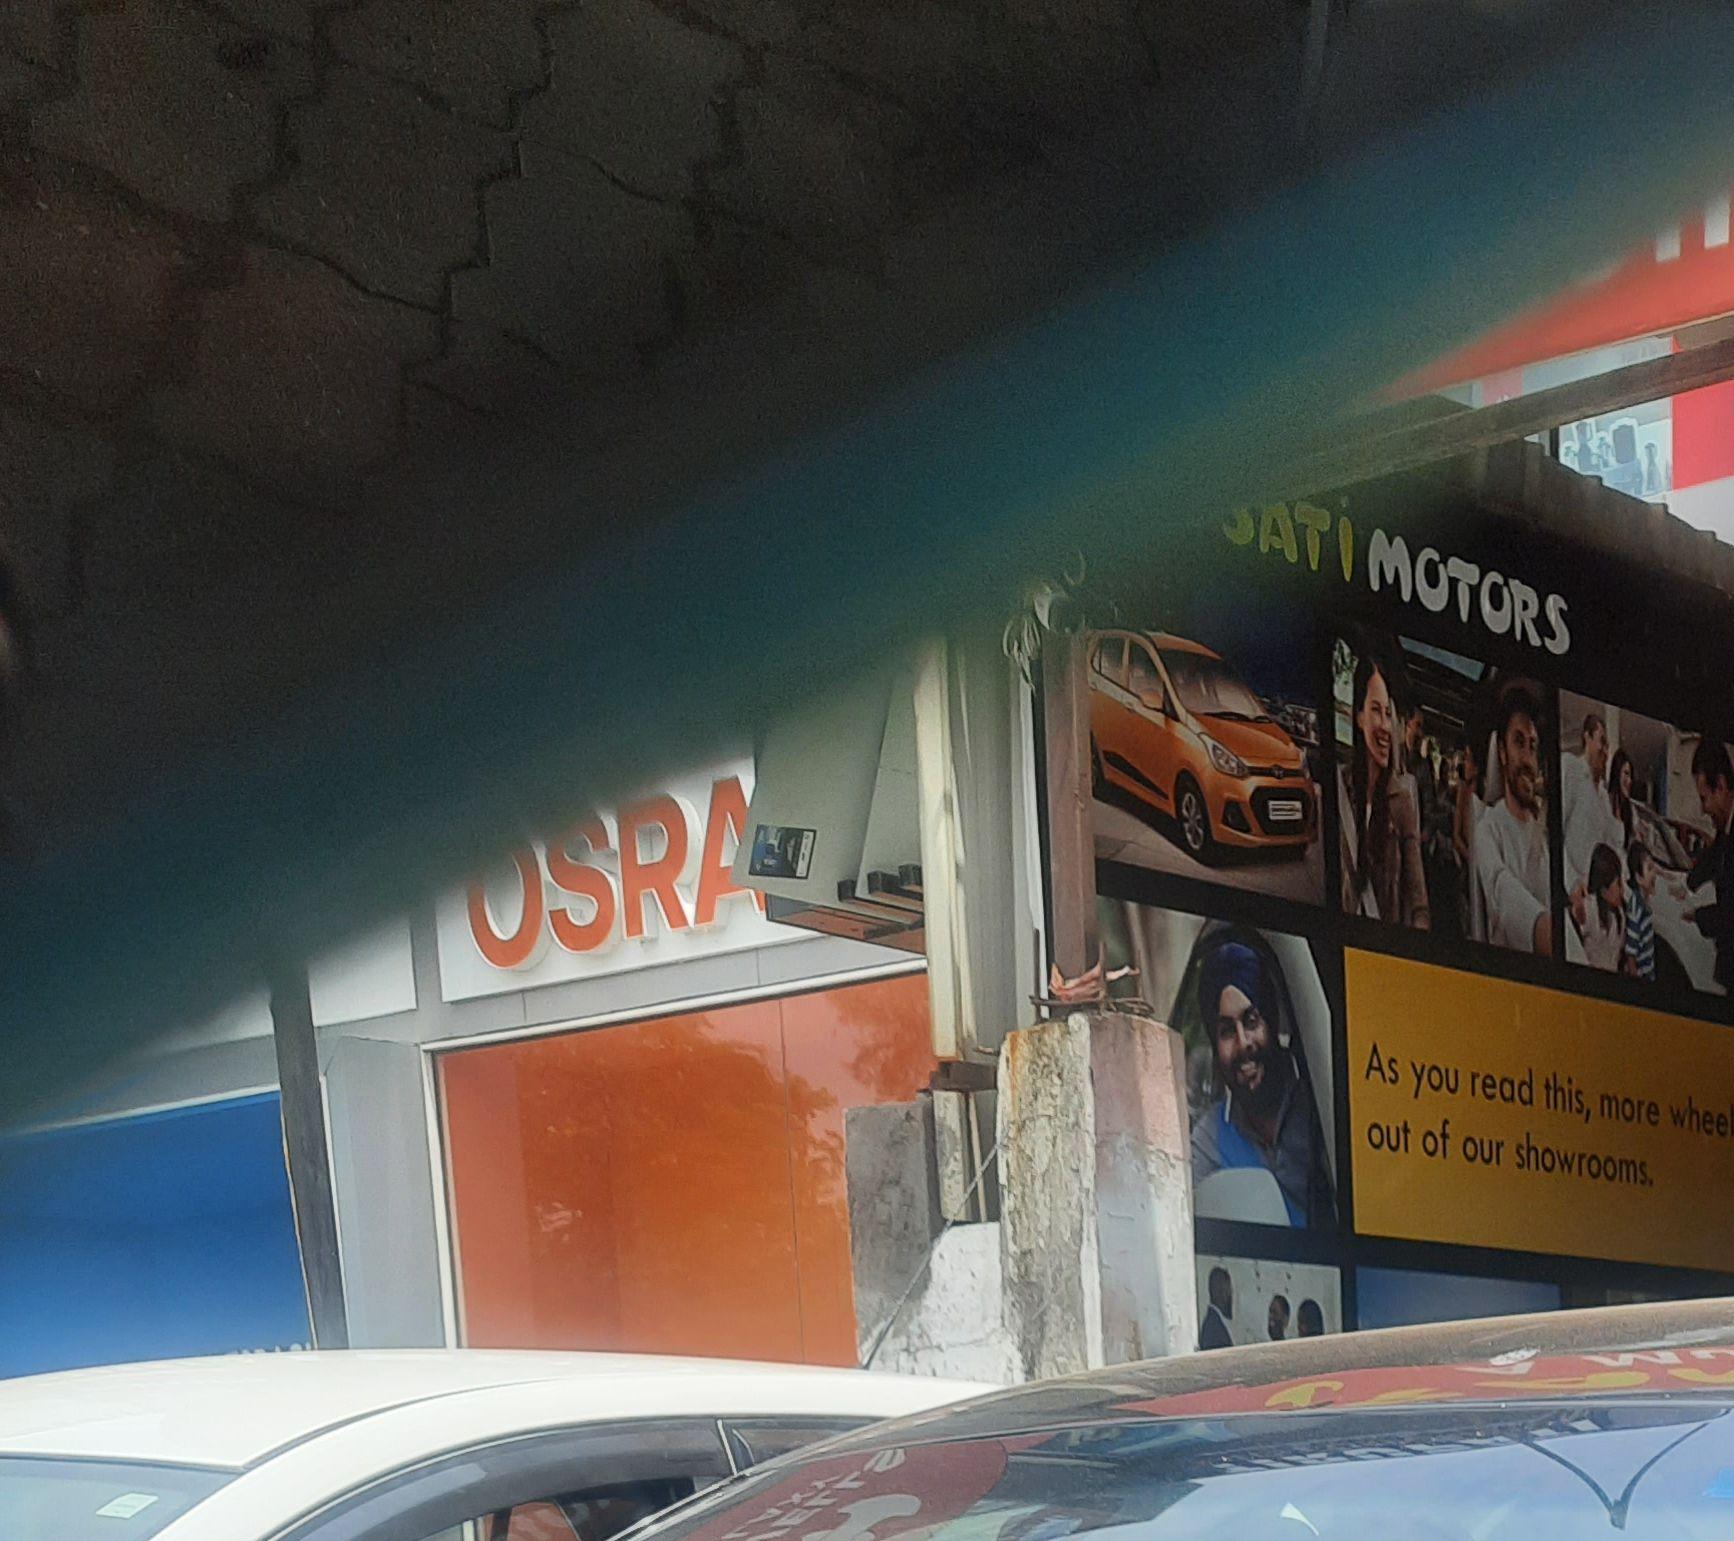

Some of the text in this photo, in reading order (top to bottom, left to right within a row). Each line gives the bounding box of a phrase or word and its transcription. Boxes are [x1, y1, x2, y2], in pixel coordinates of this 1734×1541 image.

[1368, 528, 1571, 655] MOTORS
[1365, 1042, 1399, 1085] As
[1410, 1060, 1460, 1099] you
[1471, 1068, 1534, 1107] read
[1544, 1071, 1591, 1124] this,
[1600, 1092, 1660, 1126] more
[1367, 1118, 1655, 1187] out of our showrooms.
